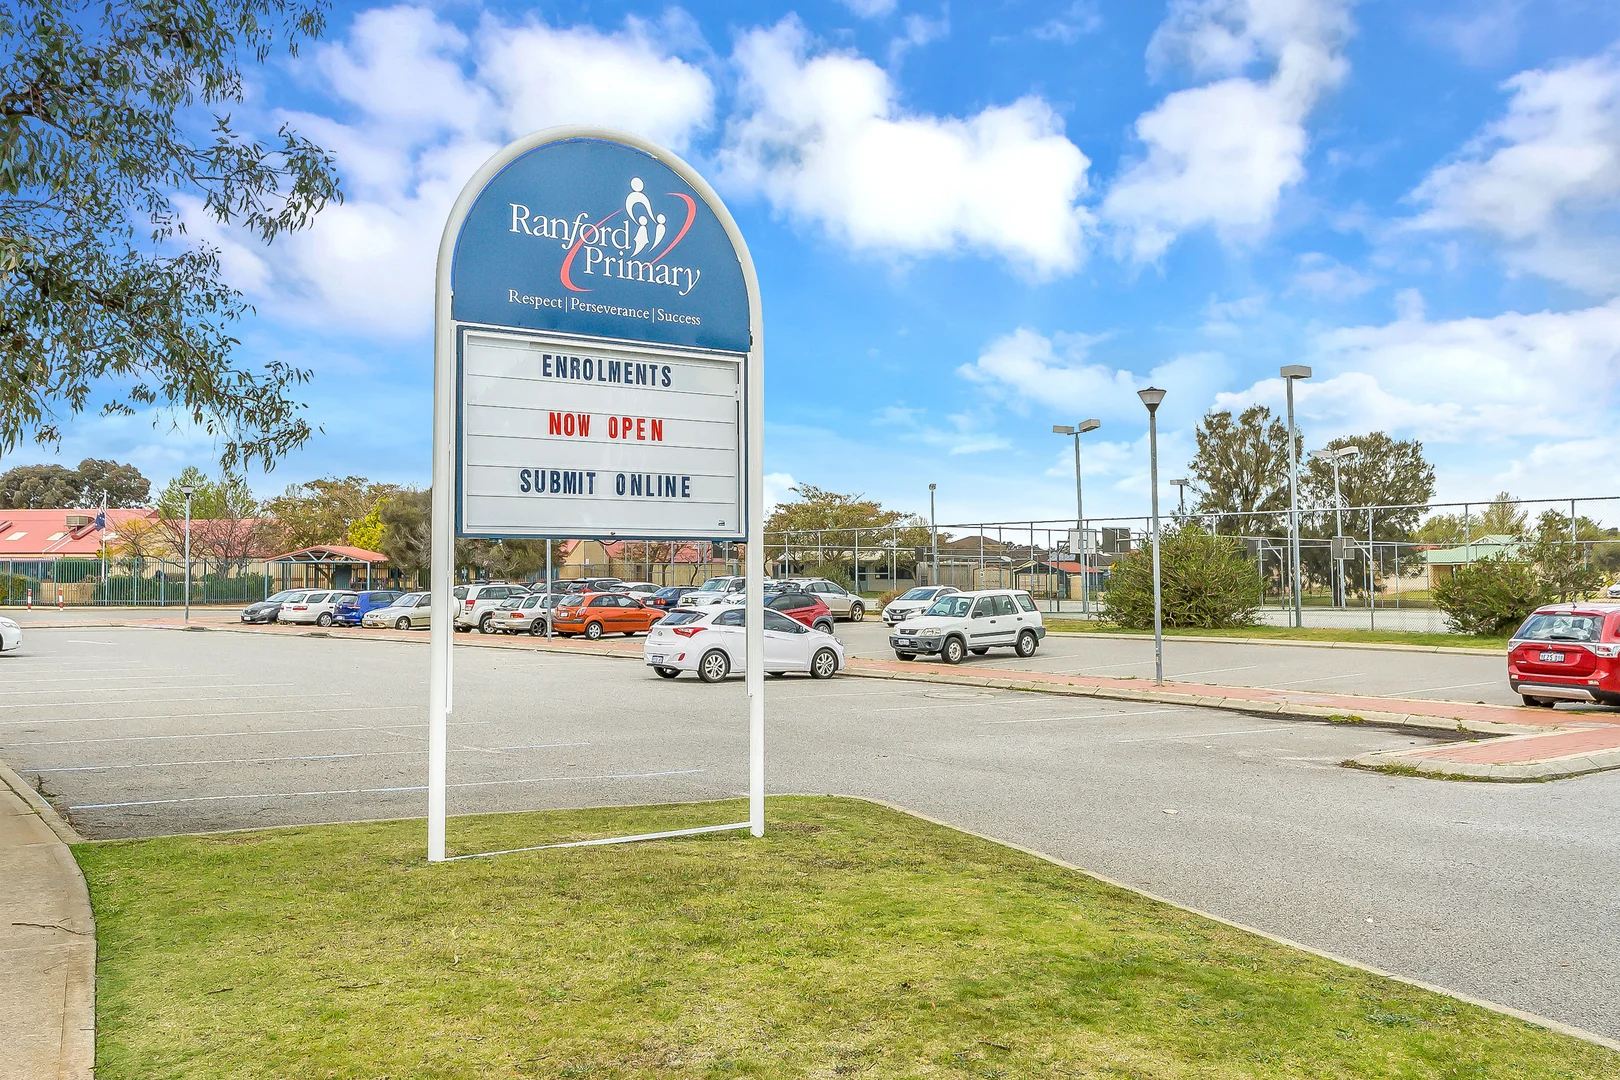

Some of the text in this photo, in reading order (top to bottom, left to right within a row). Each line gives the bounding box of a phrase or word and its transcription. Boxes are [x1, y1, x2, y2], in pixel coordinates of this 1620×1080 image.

[509, 202, 631, 250] Ranford
[584, 246, 701, 296] Primary
[508, 289, 701, 326] Respect Perseverance Success
[542, 354, 672, 387] ENROLMENTS
[549, 411, 663, 441] NOW OPEN
[520, 468, 690, 498] SUBMIT ONLINE
